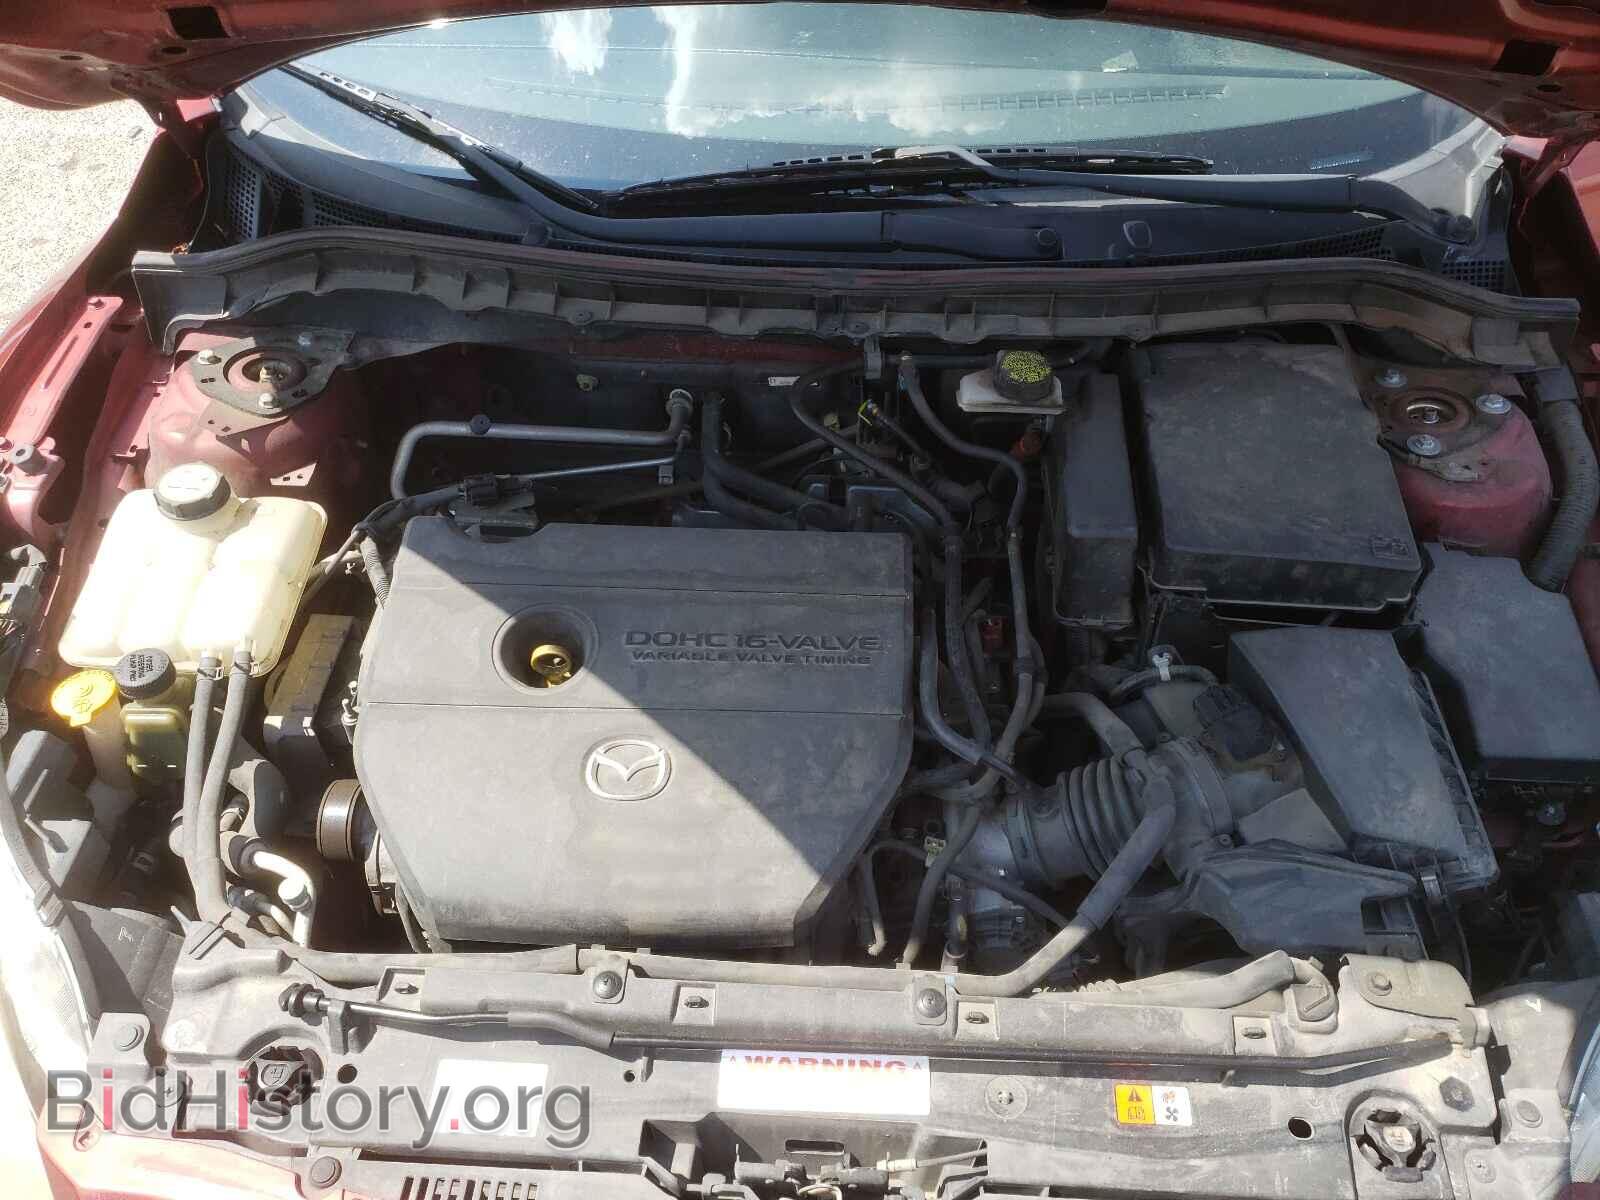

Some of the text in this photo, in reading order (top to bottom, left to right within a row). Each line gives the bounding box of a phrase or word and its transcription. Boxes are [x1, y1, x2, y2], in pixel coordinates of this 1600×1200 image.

[624, 631, 881, 651] DOHC 16-VALVE
[632, 650, 873, 666] VARIABLE VALVE TIMING
